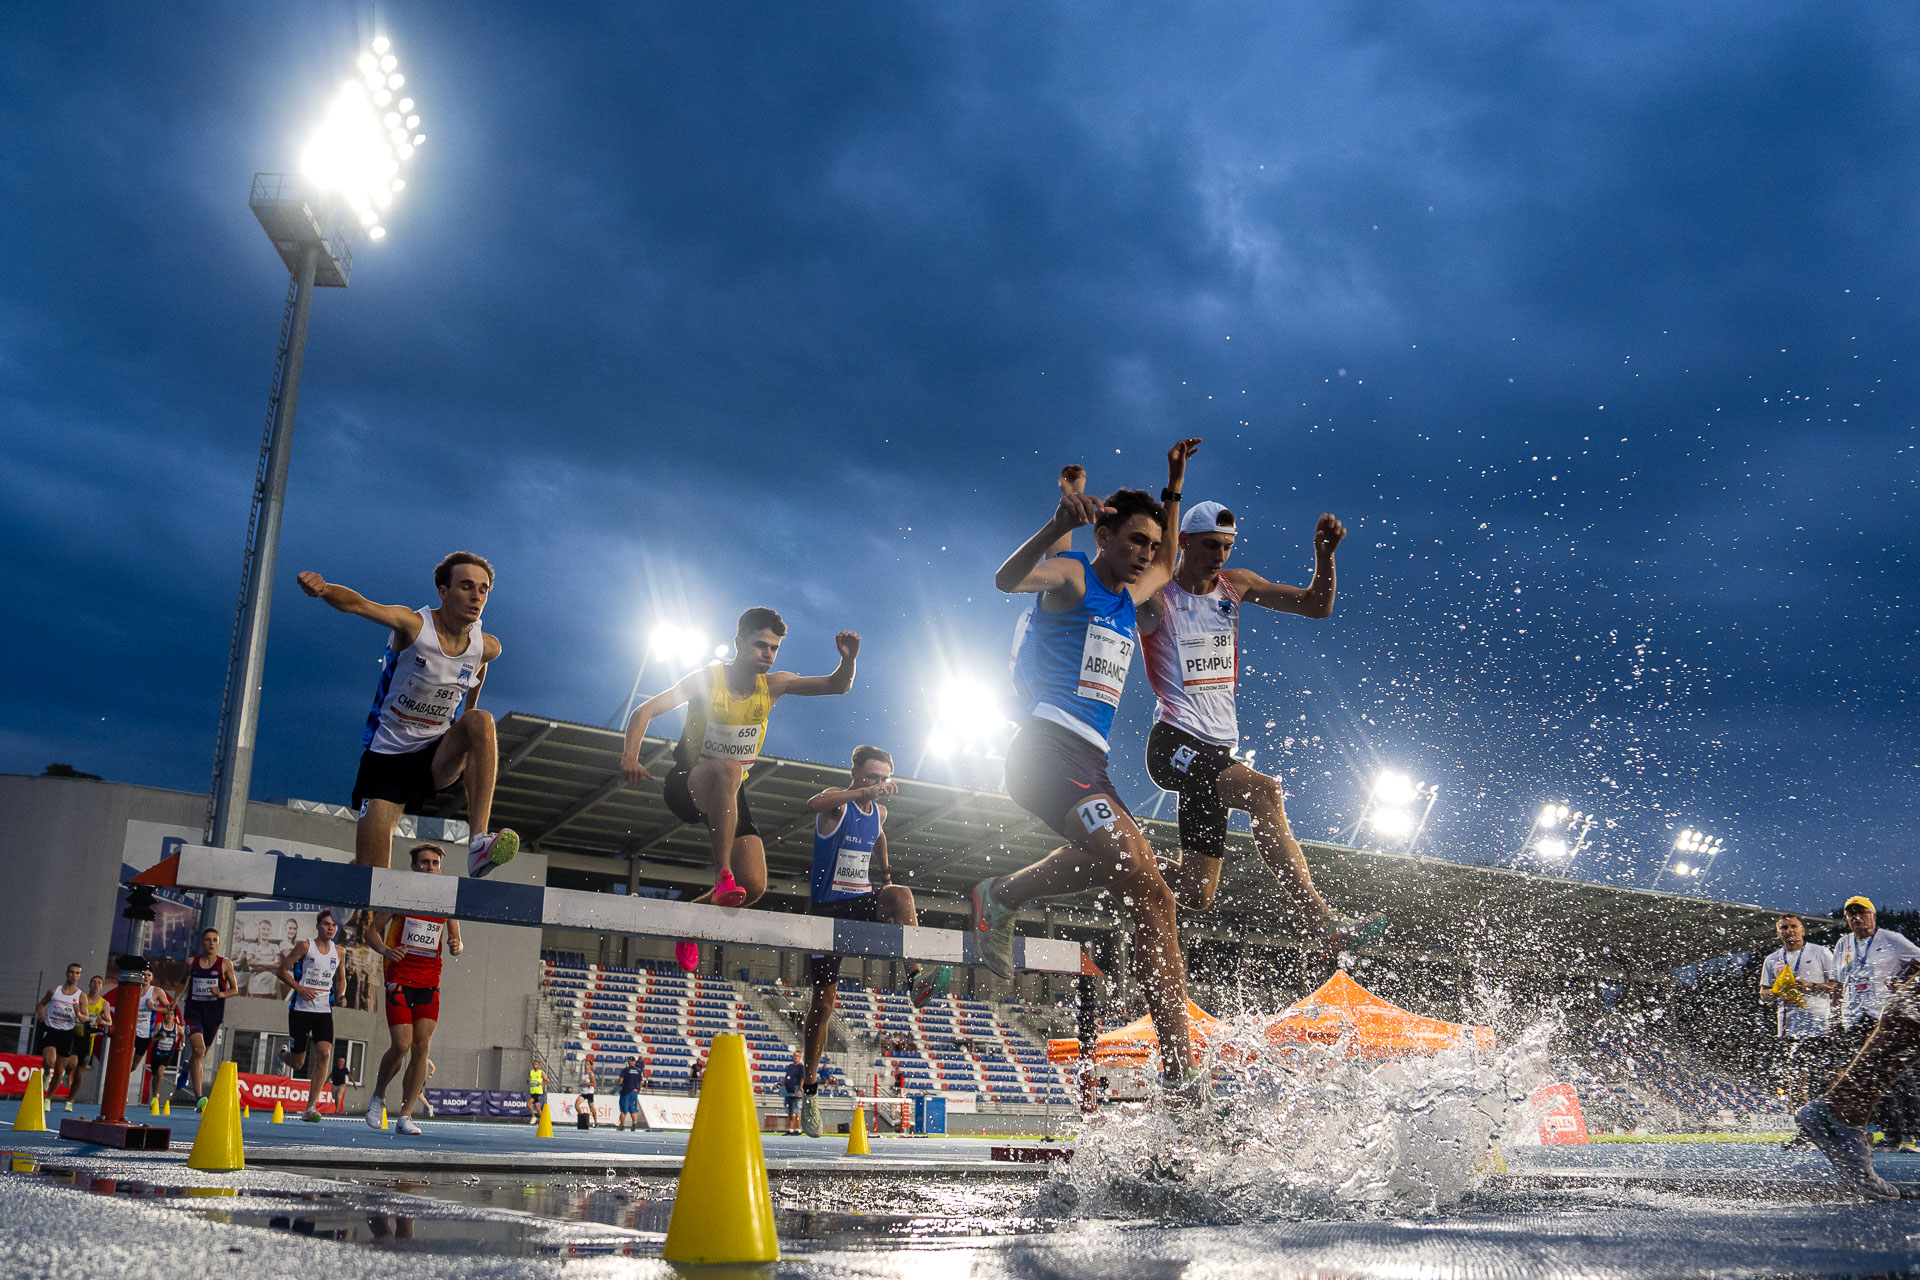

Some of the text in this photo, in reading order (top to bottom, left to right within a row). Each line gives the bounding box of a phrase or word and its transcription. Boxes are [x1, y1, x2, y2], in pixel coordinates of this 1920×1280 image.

[1213, 634, 1232, 648] 381
[434, 689, 455, 700] 581
[397, 693, 450, 717] CHRABĄSZCZ
[737, 727, 757, 738] 650
[704, 739, 756, 755] OGONOWSKI
[1174, 747, 1194, 768] 14
[1081, 802, 1112, 826] 18
[426, 923, 441, 933] 358
[407, 932, 436, 945] KOBZA
[289, 1089, 336, 1103] OREN
[442, 1098, 468, 1106] RADOM
[503, 1100, 527, 1108] RADOM
